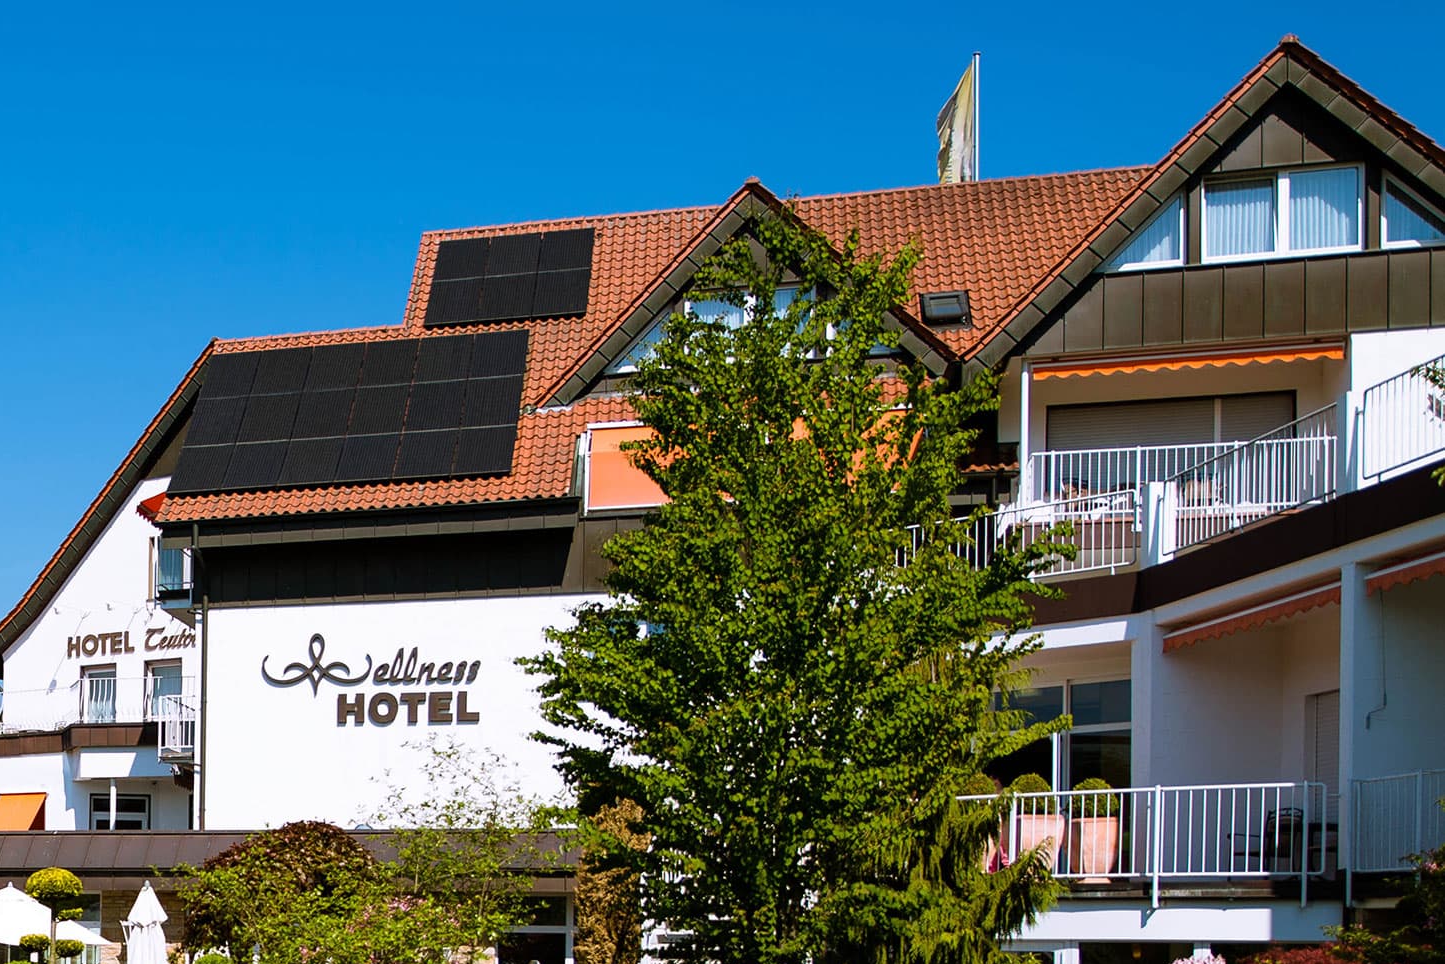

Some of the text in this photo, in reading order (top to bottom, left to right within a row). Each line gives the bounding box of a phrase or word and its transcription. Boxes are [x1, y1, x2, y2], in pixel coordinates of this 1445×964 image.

[67, 631, 135, 658] HOTEL
[261, 633, 481, 698] Wellness
[337, 691, 480, 727] HOTEL
